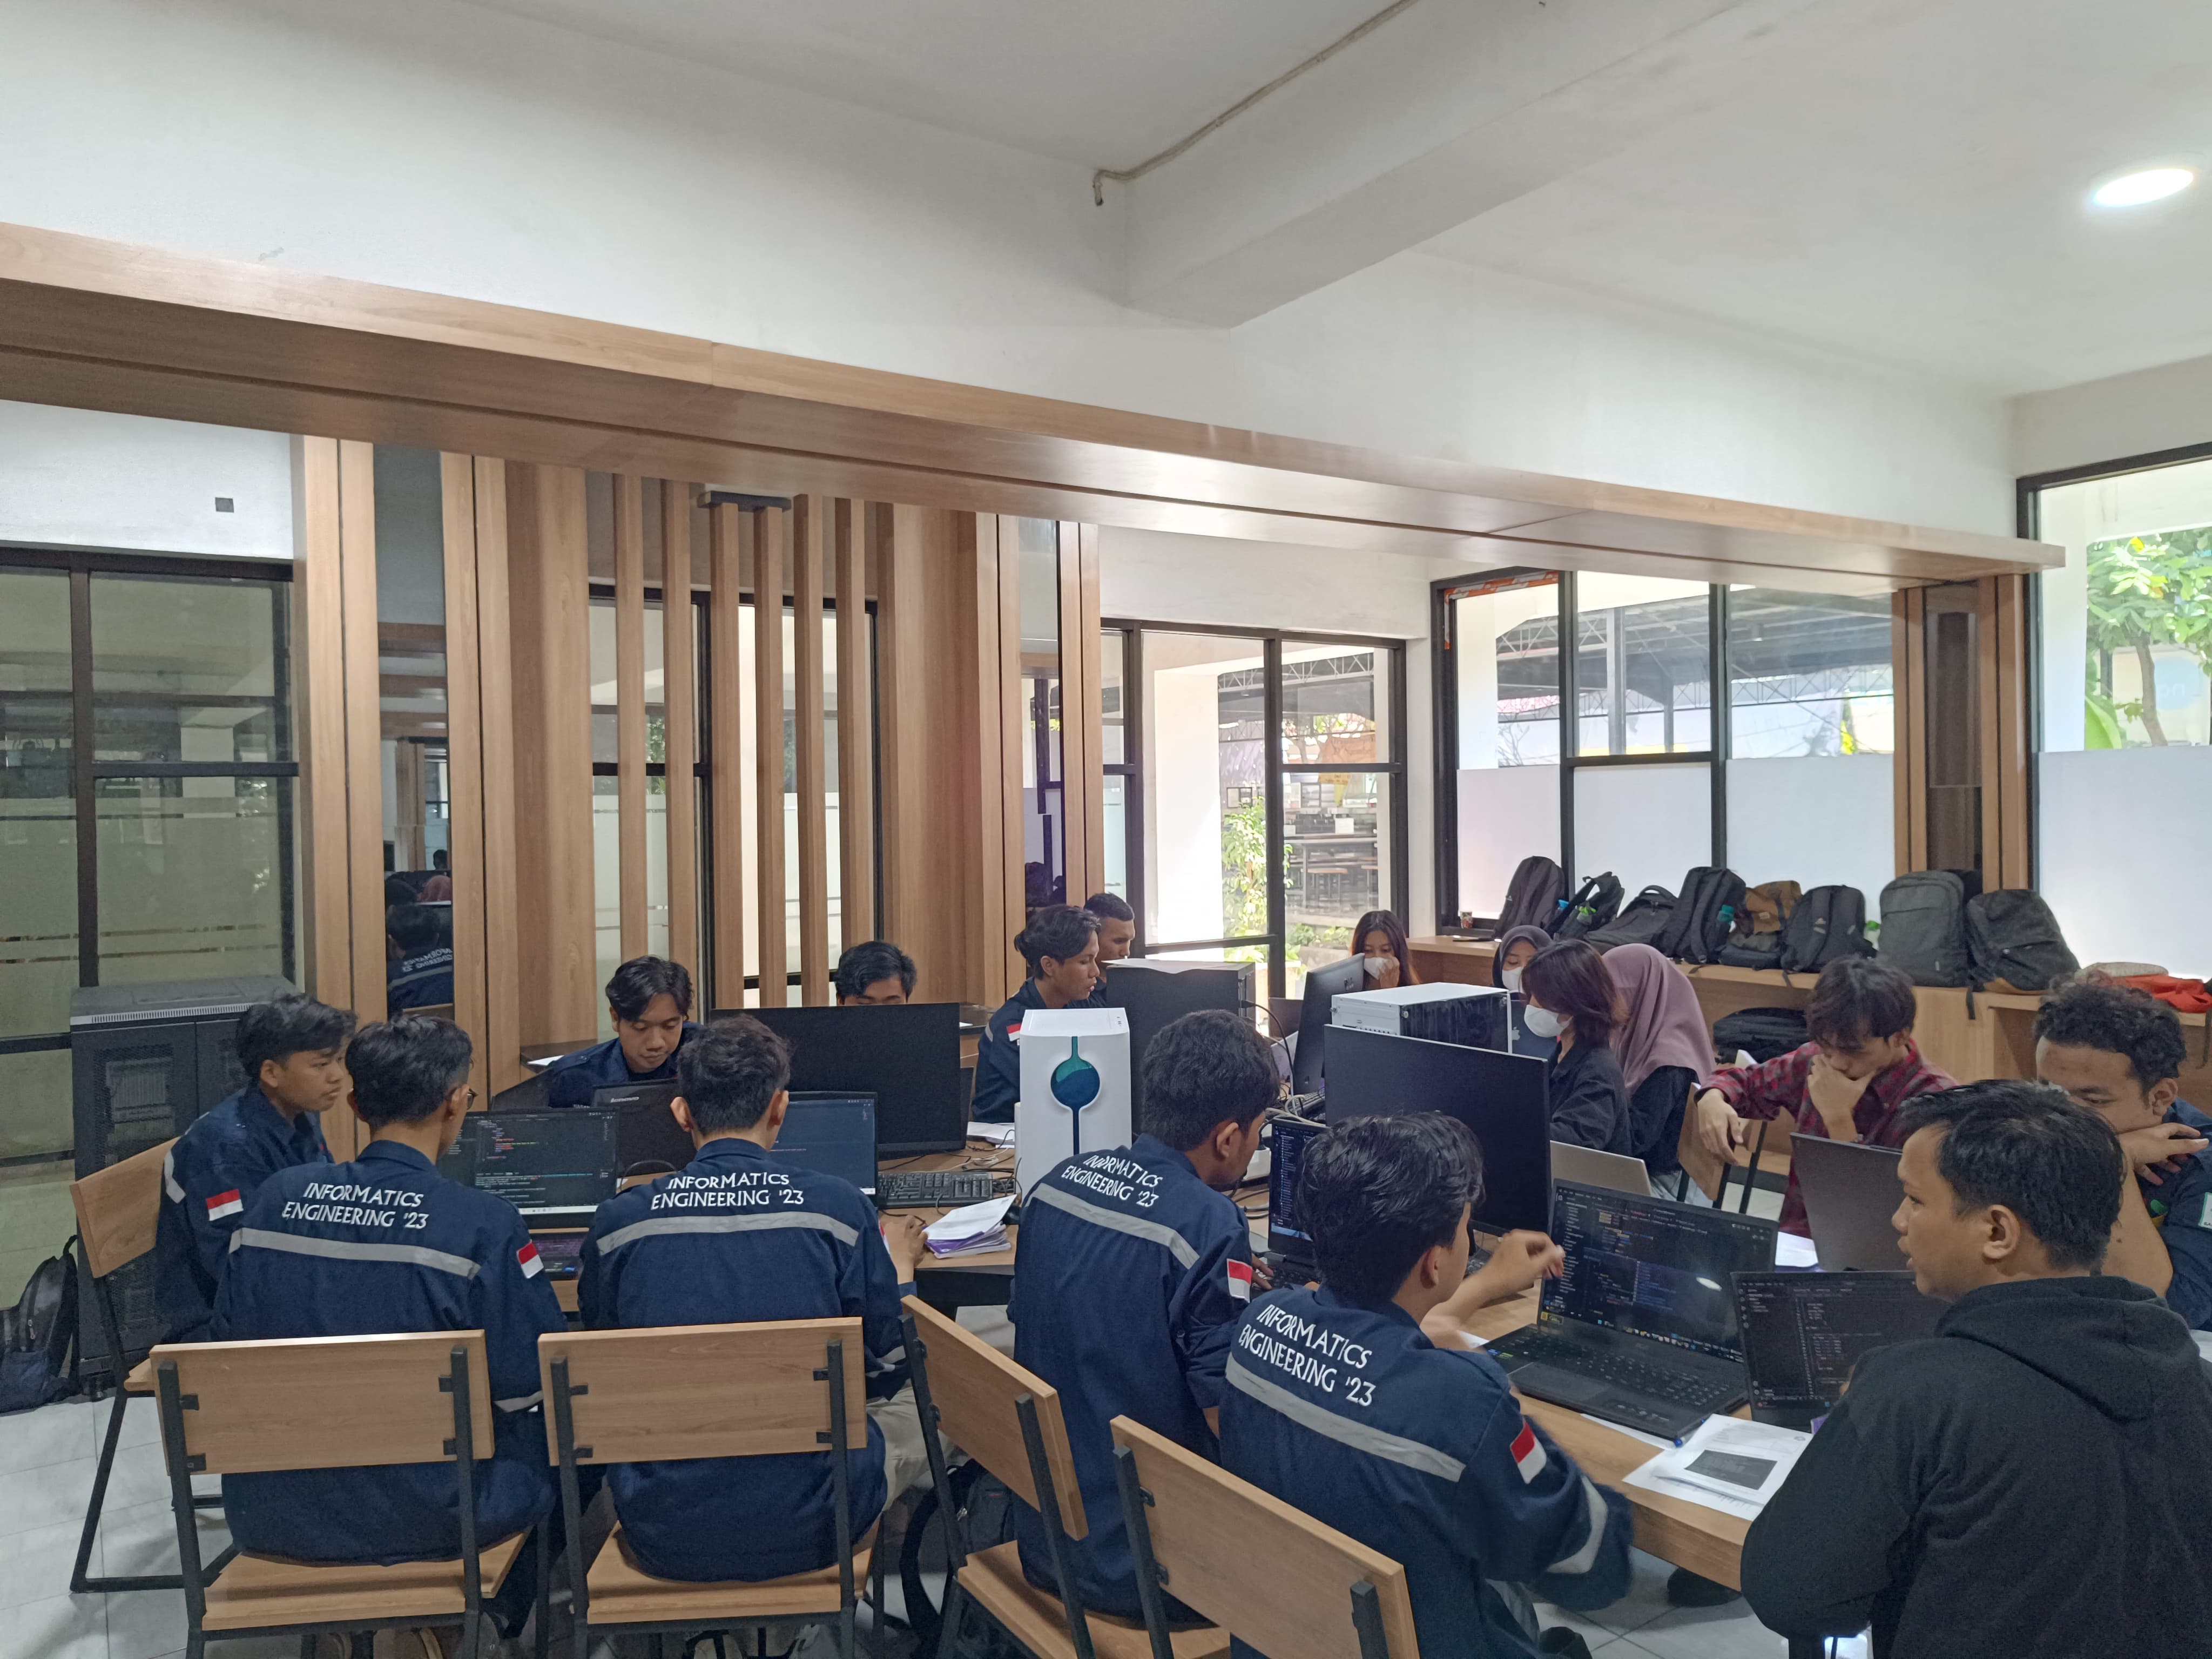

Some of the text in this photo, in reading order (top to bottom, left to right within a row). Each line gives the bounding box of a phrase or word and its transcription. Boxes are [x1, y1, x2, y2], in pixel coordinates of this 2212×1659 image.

[665, 1172, 790, 1189] INFORMATICS
[1061, 1165, 1159, 1207] ENGINEERING '23
[303, 1182, 424, 1207] INFORMATICS
[651, 1189, 804, 1210] ENGINEERING '23
[281, 1202, 430, 1229] ENGINEERING '23
[1256, 1304, 1372, 1368] INFORMATICS
[1238, 1324, 1376, 1407] ENGINEERING '23
